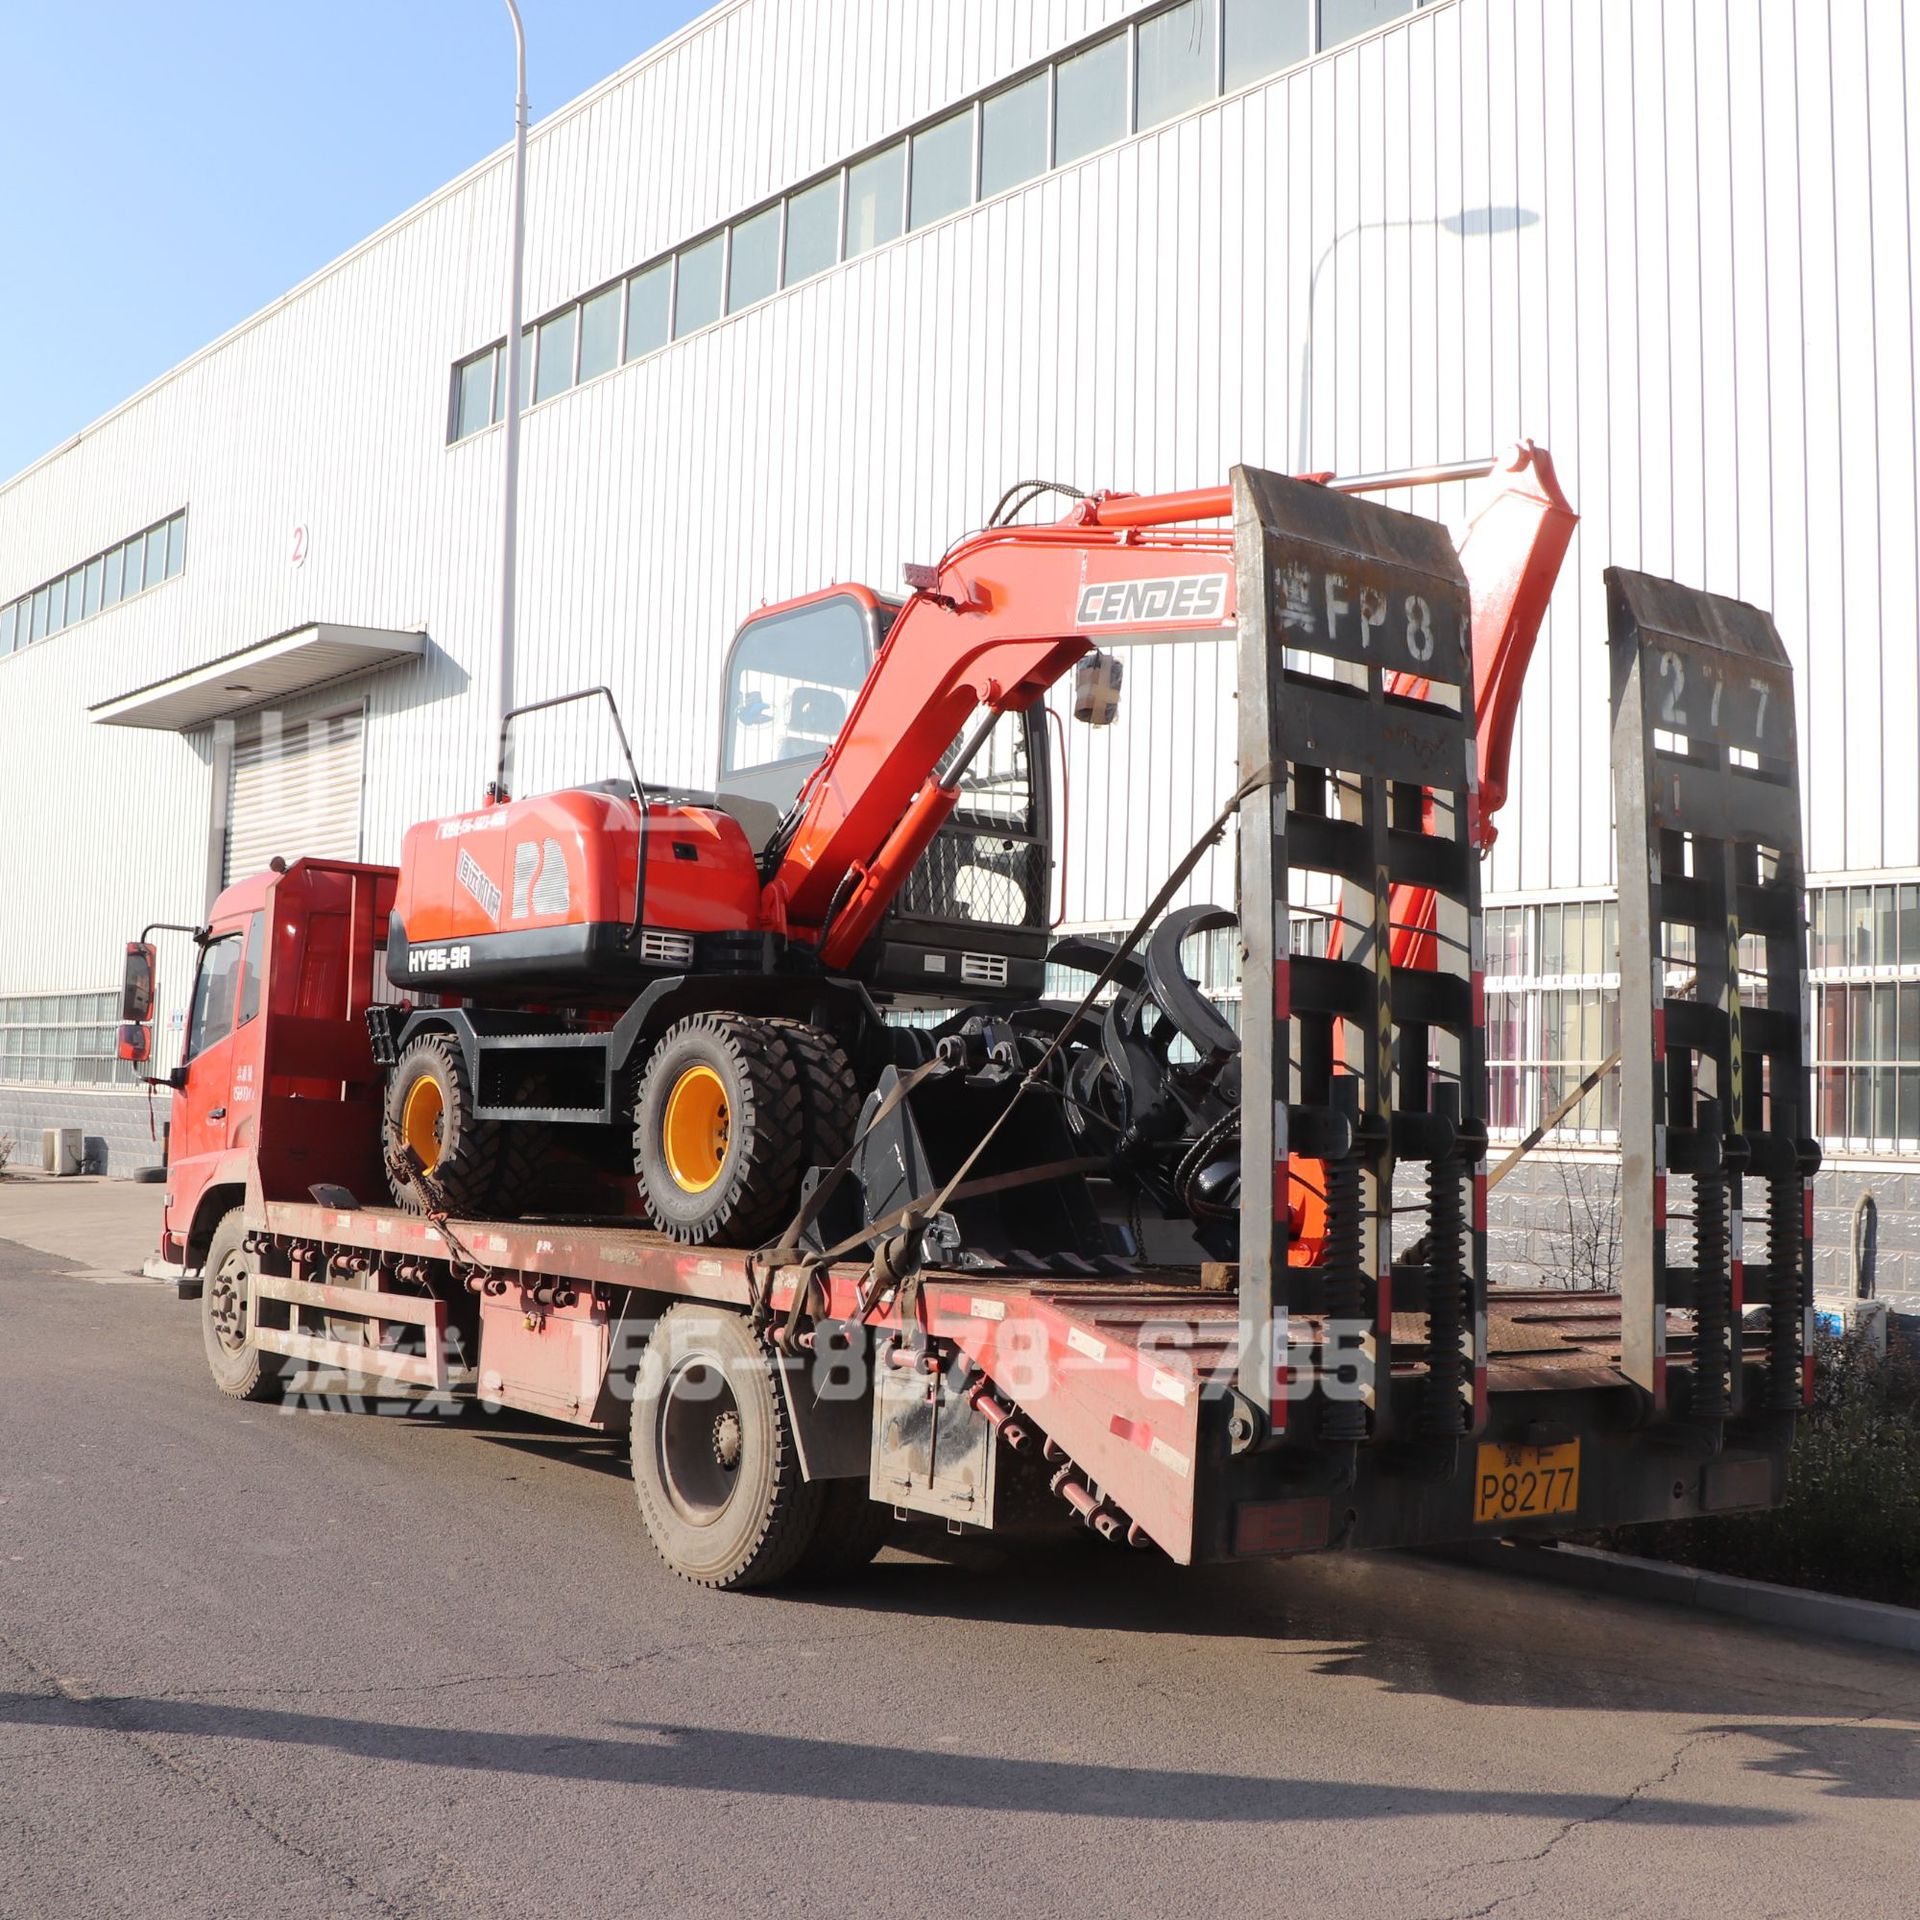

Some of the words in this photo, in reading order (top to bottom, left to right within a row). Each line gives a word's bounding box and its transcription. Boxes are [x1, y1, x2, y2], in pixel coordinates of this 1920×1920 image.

[292, 527, 303, 562] 2
[1078, 577, 1223, 622] CENDES
[408, 946, 471, 973] HY95-9A
[1480, 1468, 1574, 1516] P8277
